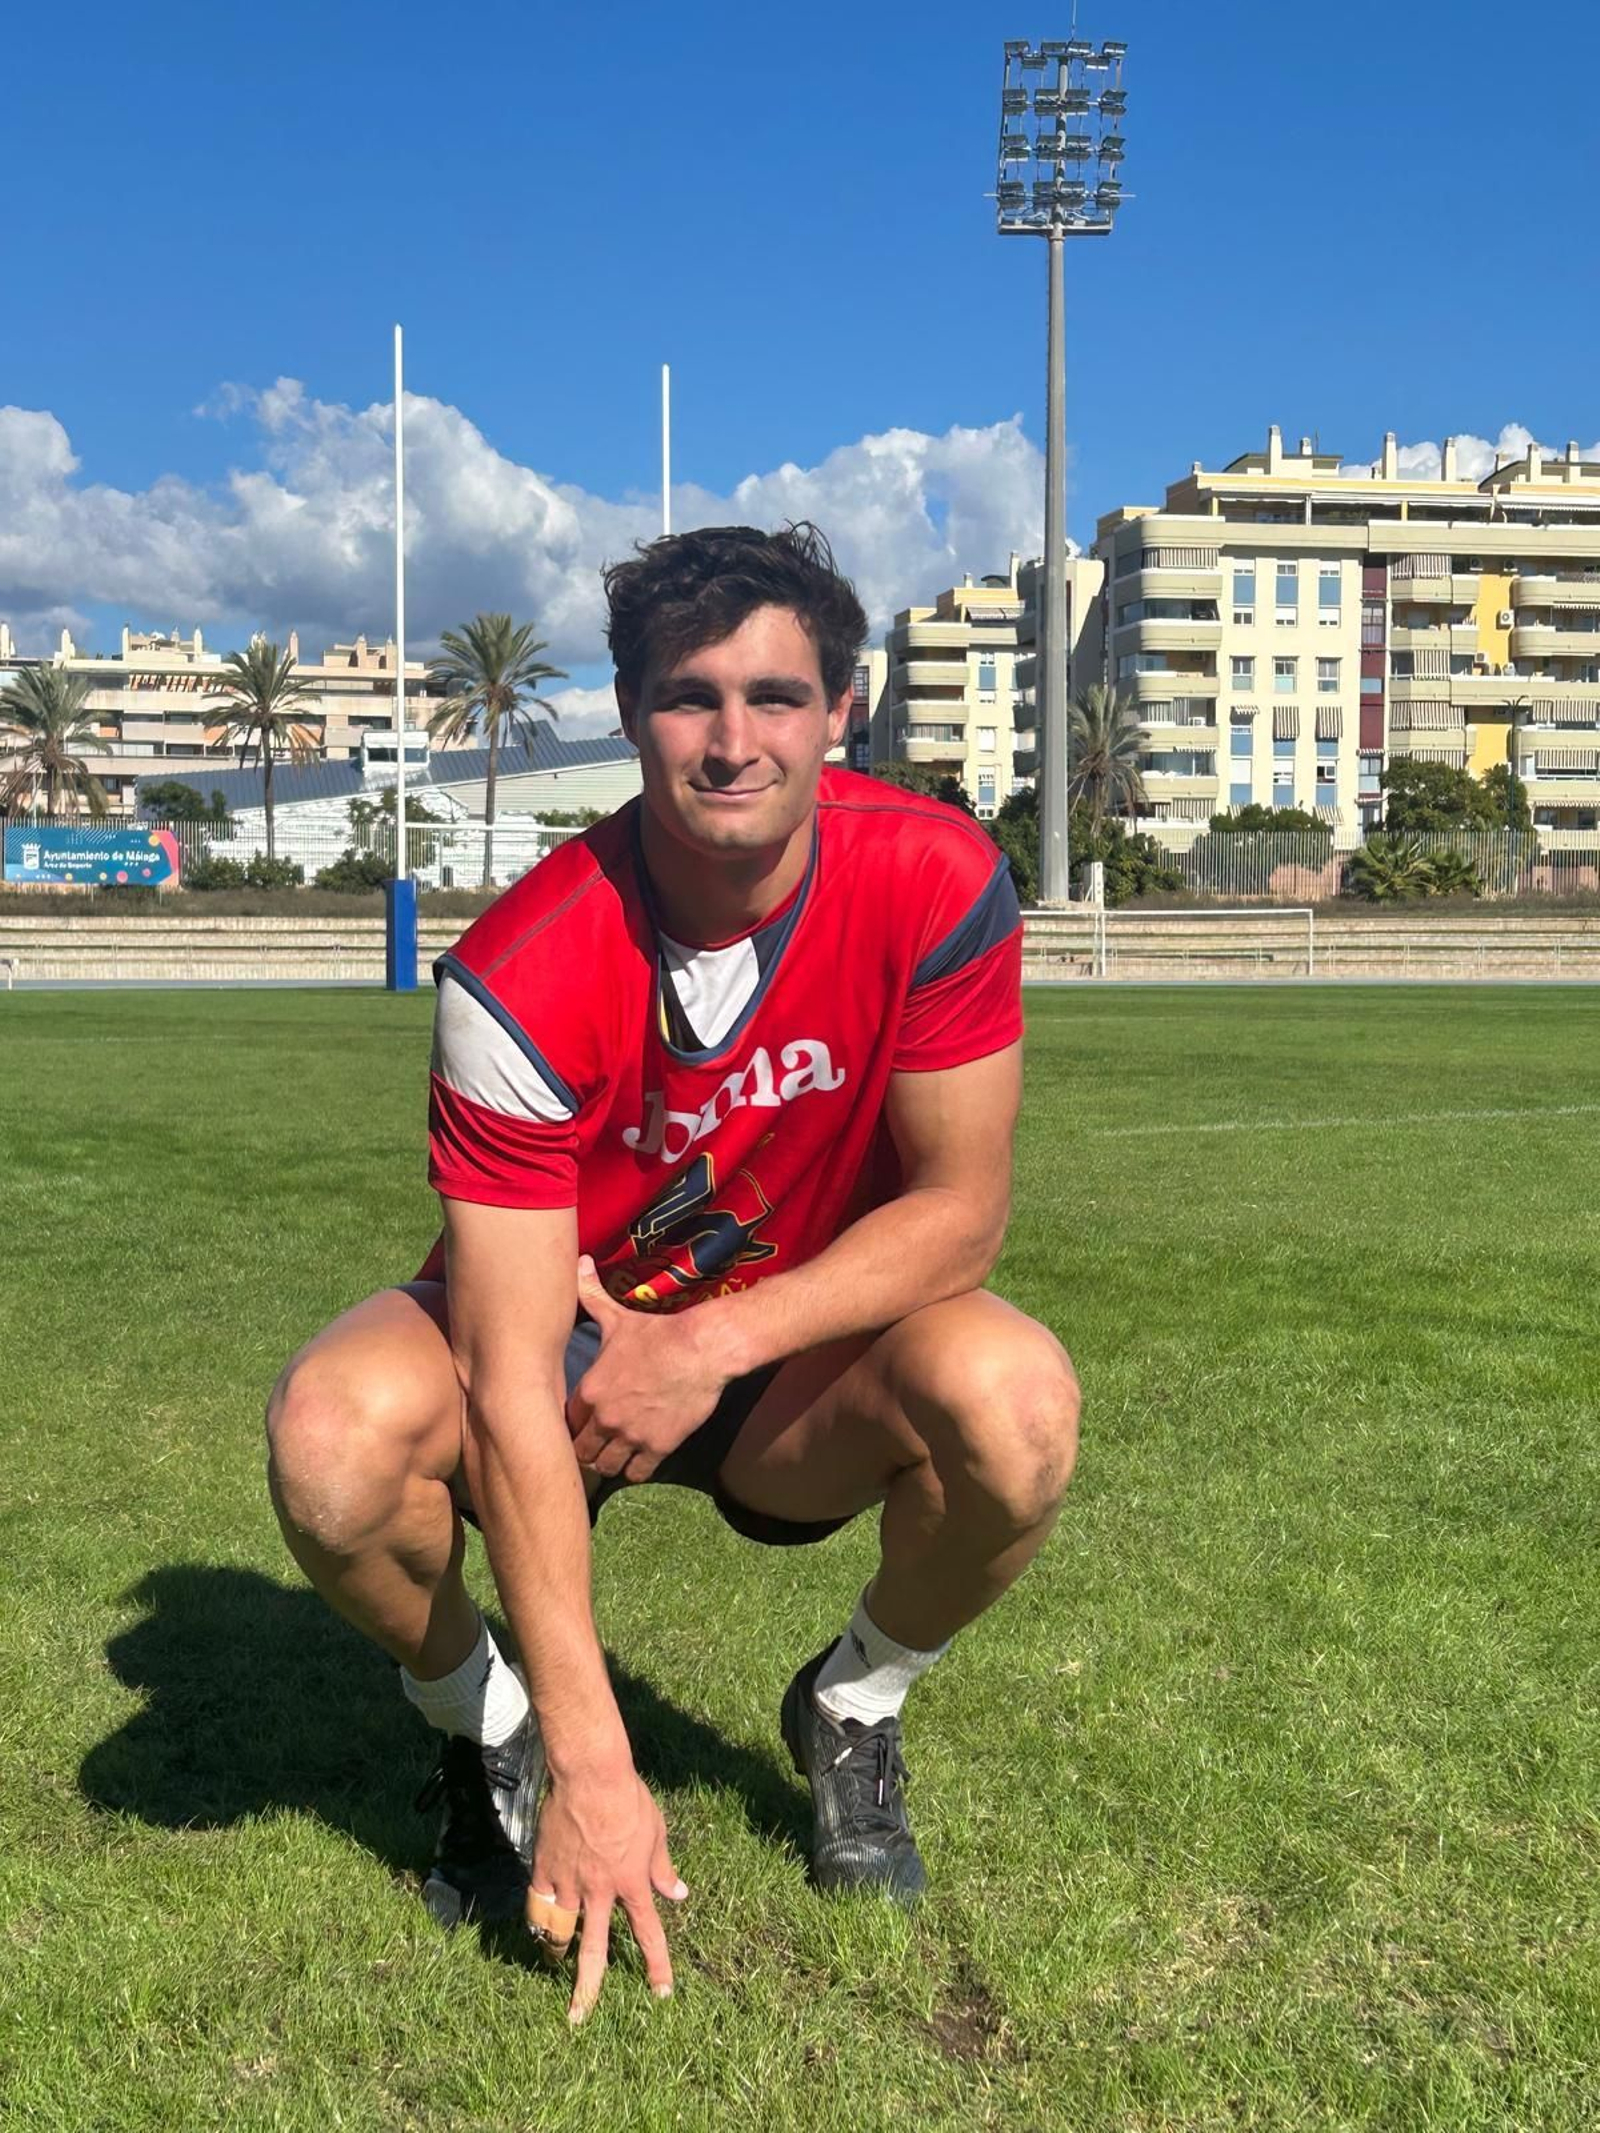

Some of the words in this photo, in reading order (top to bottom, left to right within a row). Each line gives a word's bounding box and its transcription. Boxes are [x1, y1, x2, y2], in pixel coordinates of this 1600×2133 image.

[43, 850, 110, 861] Ayuntamiento
[111, 850, 124, 861] de
[126, 850, 160, 863] Málaga
[621, 1038, 846, 1164] Joma
[606, 1269, 765, 1309] ESPÑ
